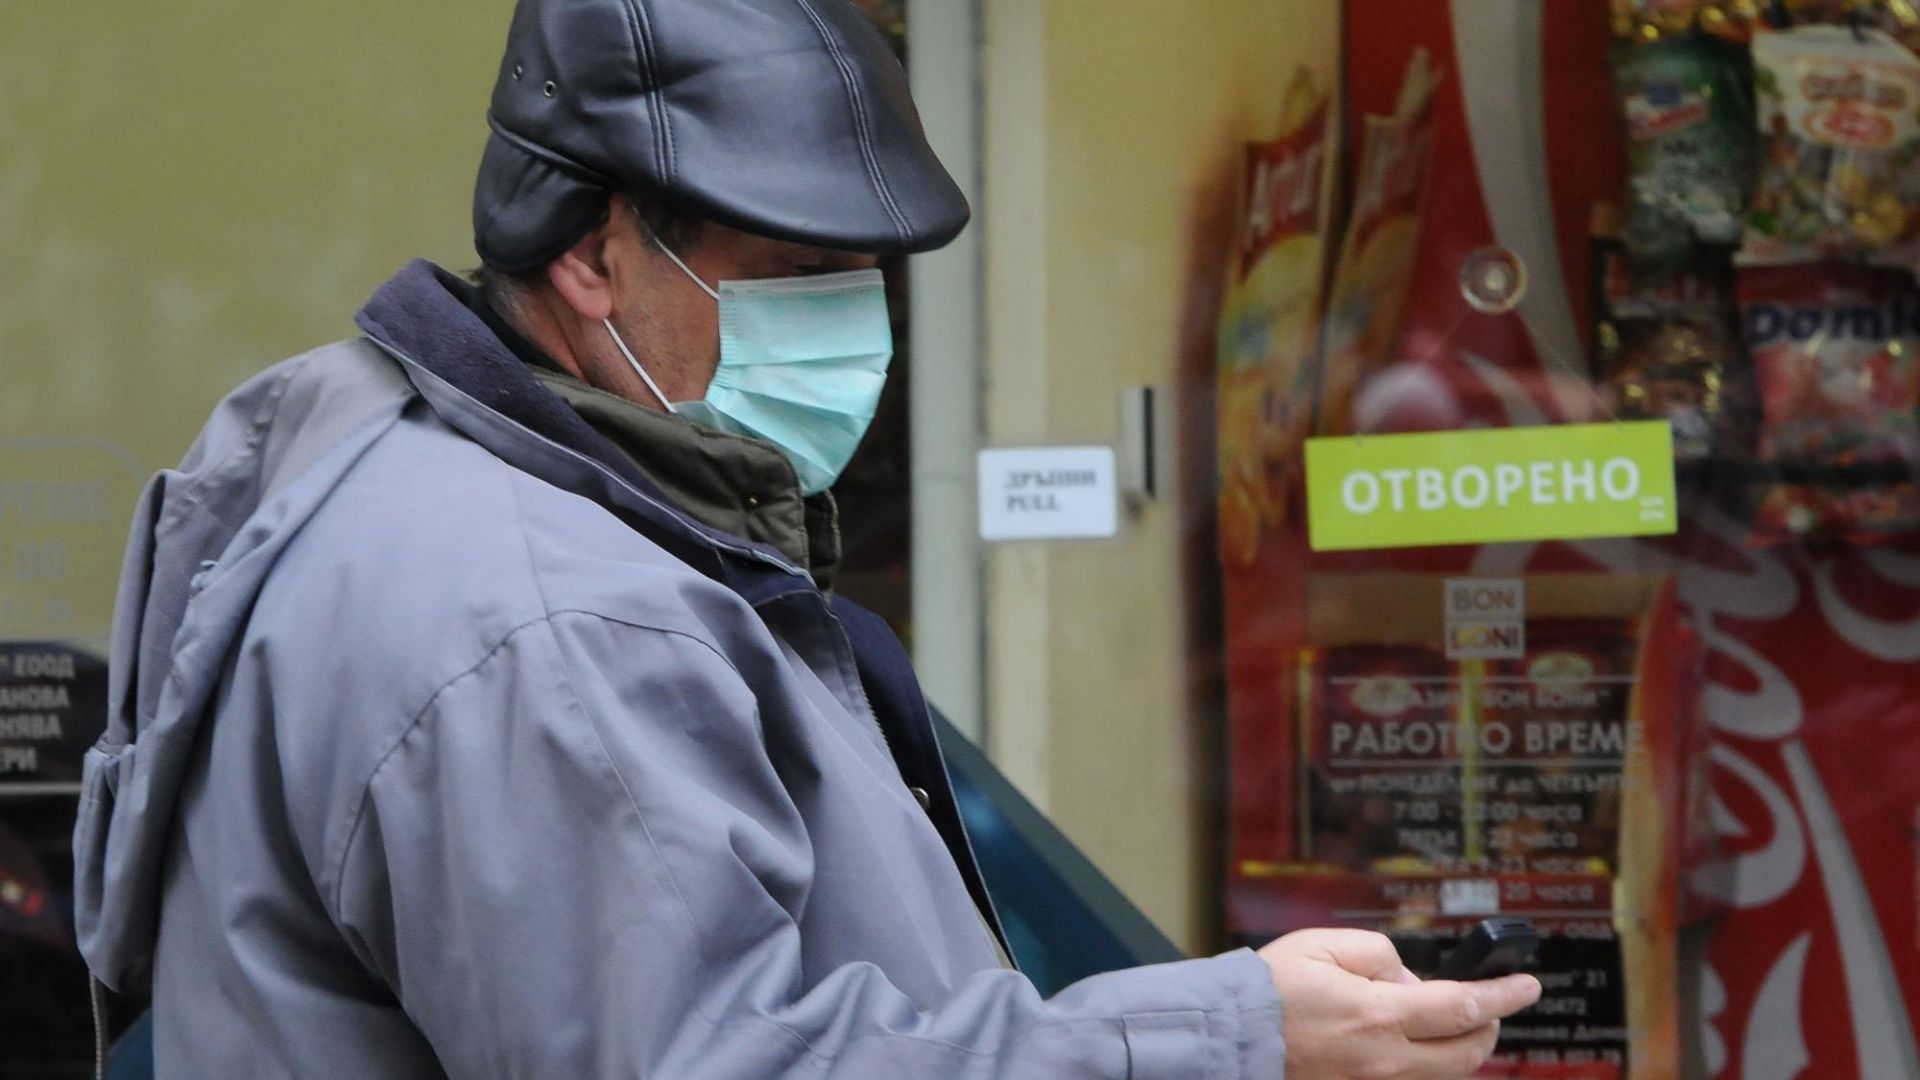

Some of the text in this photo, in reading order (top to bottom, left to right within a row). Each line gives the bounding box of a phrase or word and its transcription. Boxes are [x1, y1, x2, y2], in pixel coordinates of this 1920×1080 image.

[1341, 456, 1641, 514] ОТВОРЕНО
[1007, 494, 1062, 513] PULL
[1454, 587, 1515, 611] BON
[15, 655, 76, 679] ЕООД
